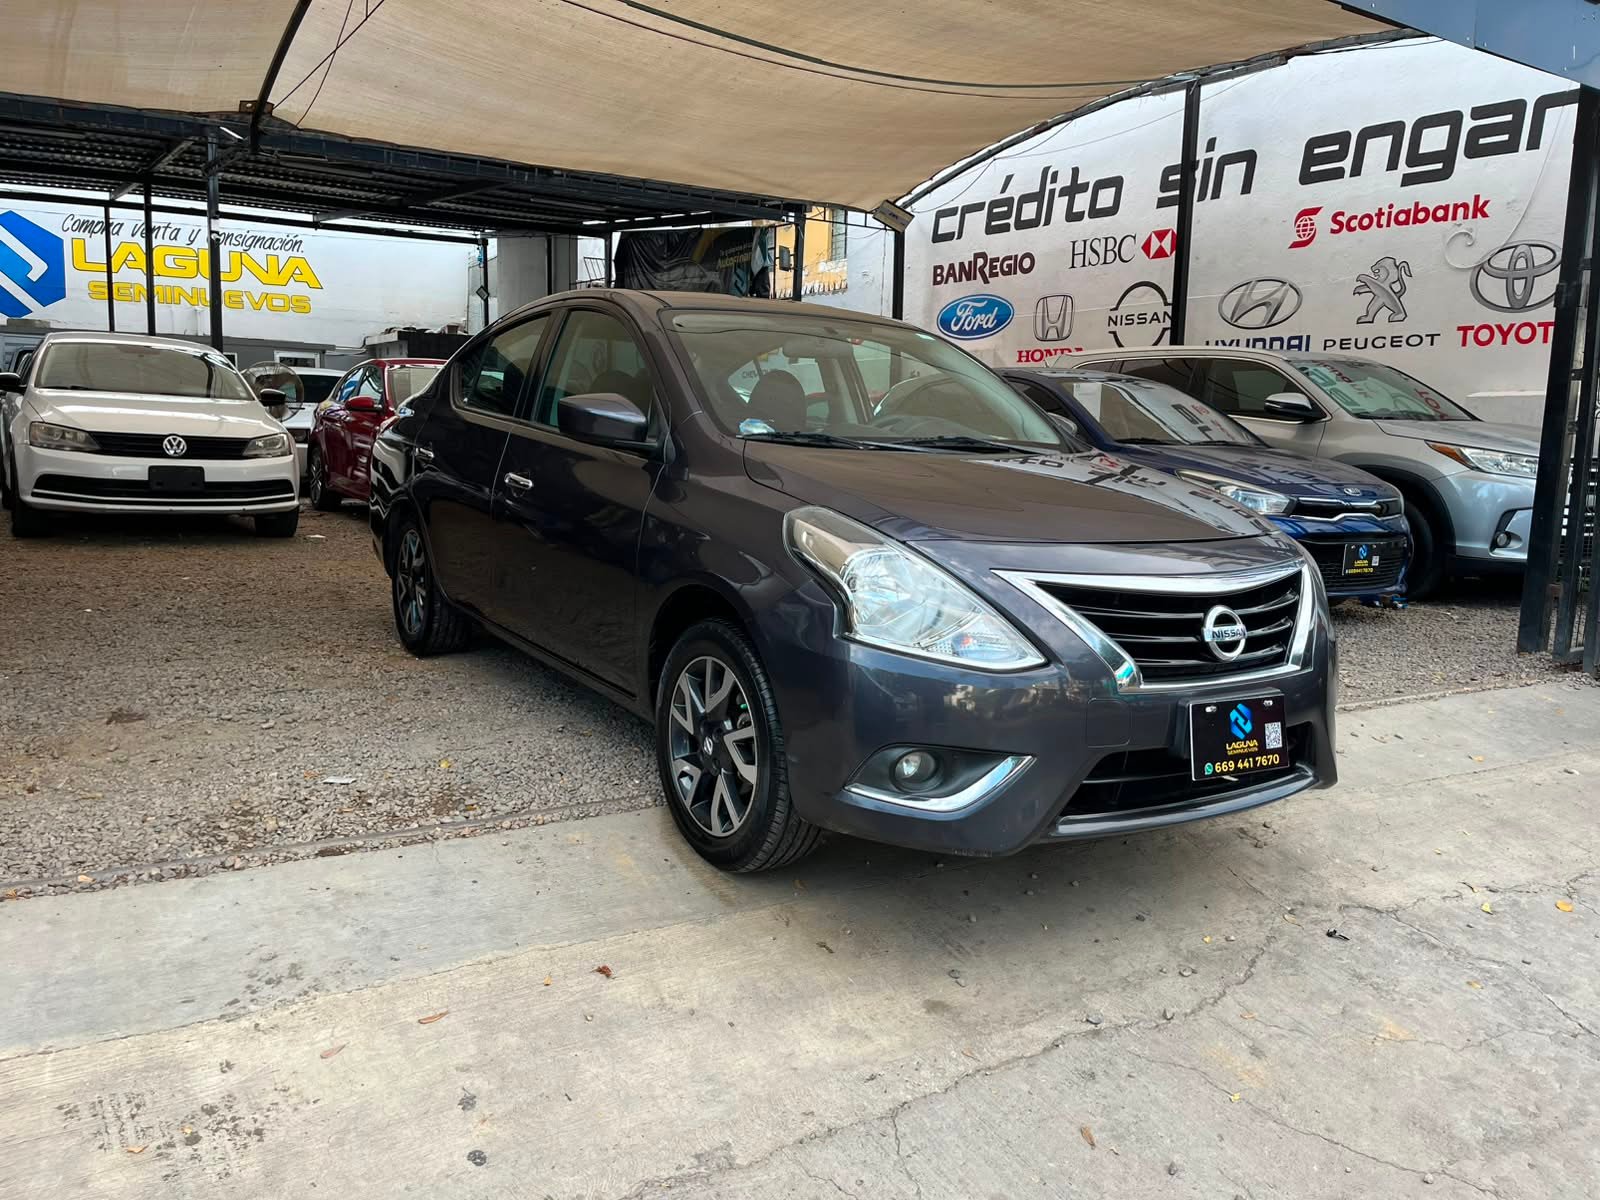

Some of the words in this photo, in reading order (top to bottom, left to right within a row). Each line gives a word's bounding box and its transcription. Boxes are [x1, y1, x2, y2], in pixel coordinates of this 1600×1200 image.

[931, 165, 1124, 244] crédito
[1156, 137, 1257, 209] sin
[1330, 194, 1490, 234] Scotiabank
[186, 228, 201, 245] y
[207, 230, 304, 254] onsignación.
[1069, 234, 1136, 269] HSBC
[72, 238, 323, 289] LAGUNA
[932, 251, 1035, 286] BANREGIO
[951, 299, 998, 331] Ford
[1205, 335, 1311, 352] NDAI
[1323, 334, 1441, 350] PEUGEOT
[1457, 321, 1556, 347] TOYOT
[1017, 347, 1084, 362] HON
[1212, 628, 1246, 639] NISSAN
[1226, 739, 1259, 750] LAGUNA
[1215, 760, 1235, 773] 669
[1237, 757, 1254, 769] 441
[1255, 753, 1280, 767] 7670
